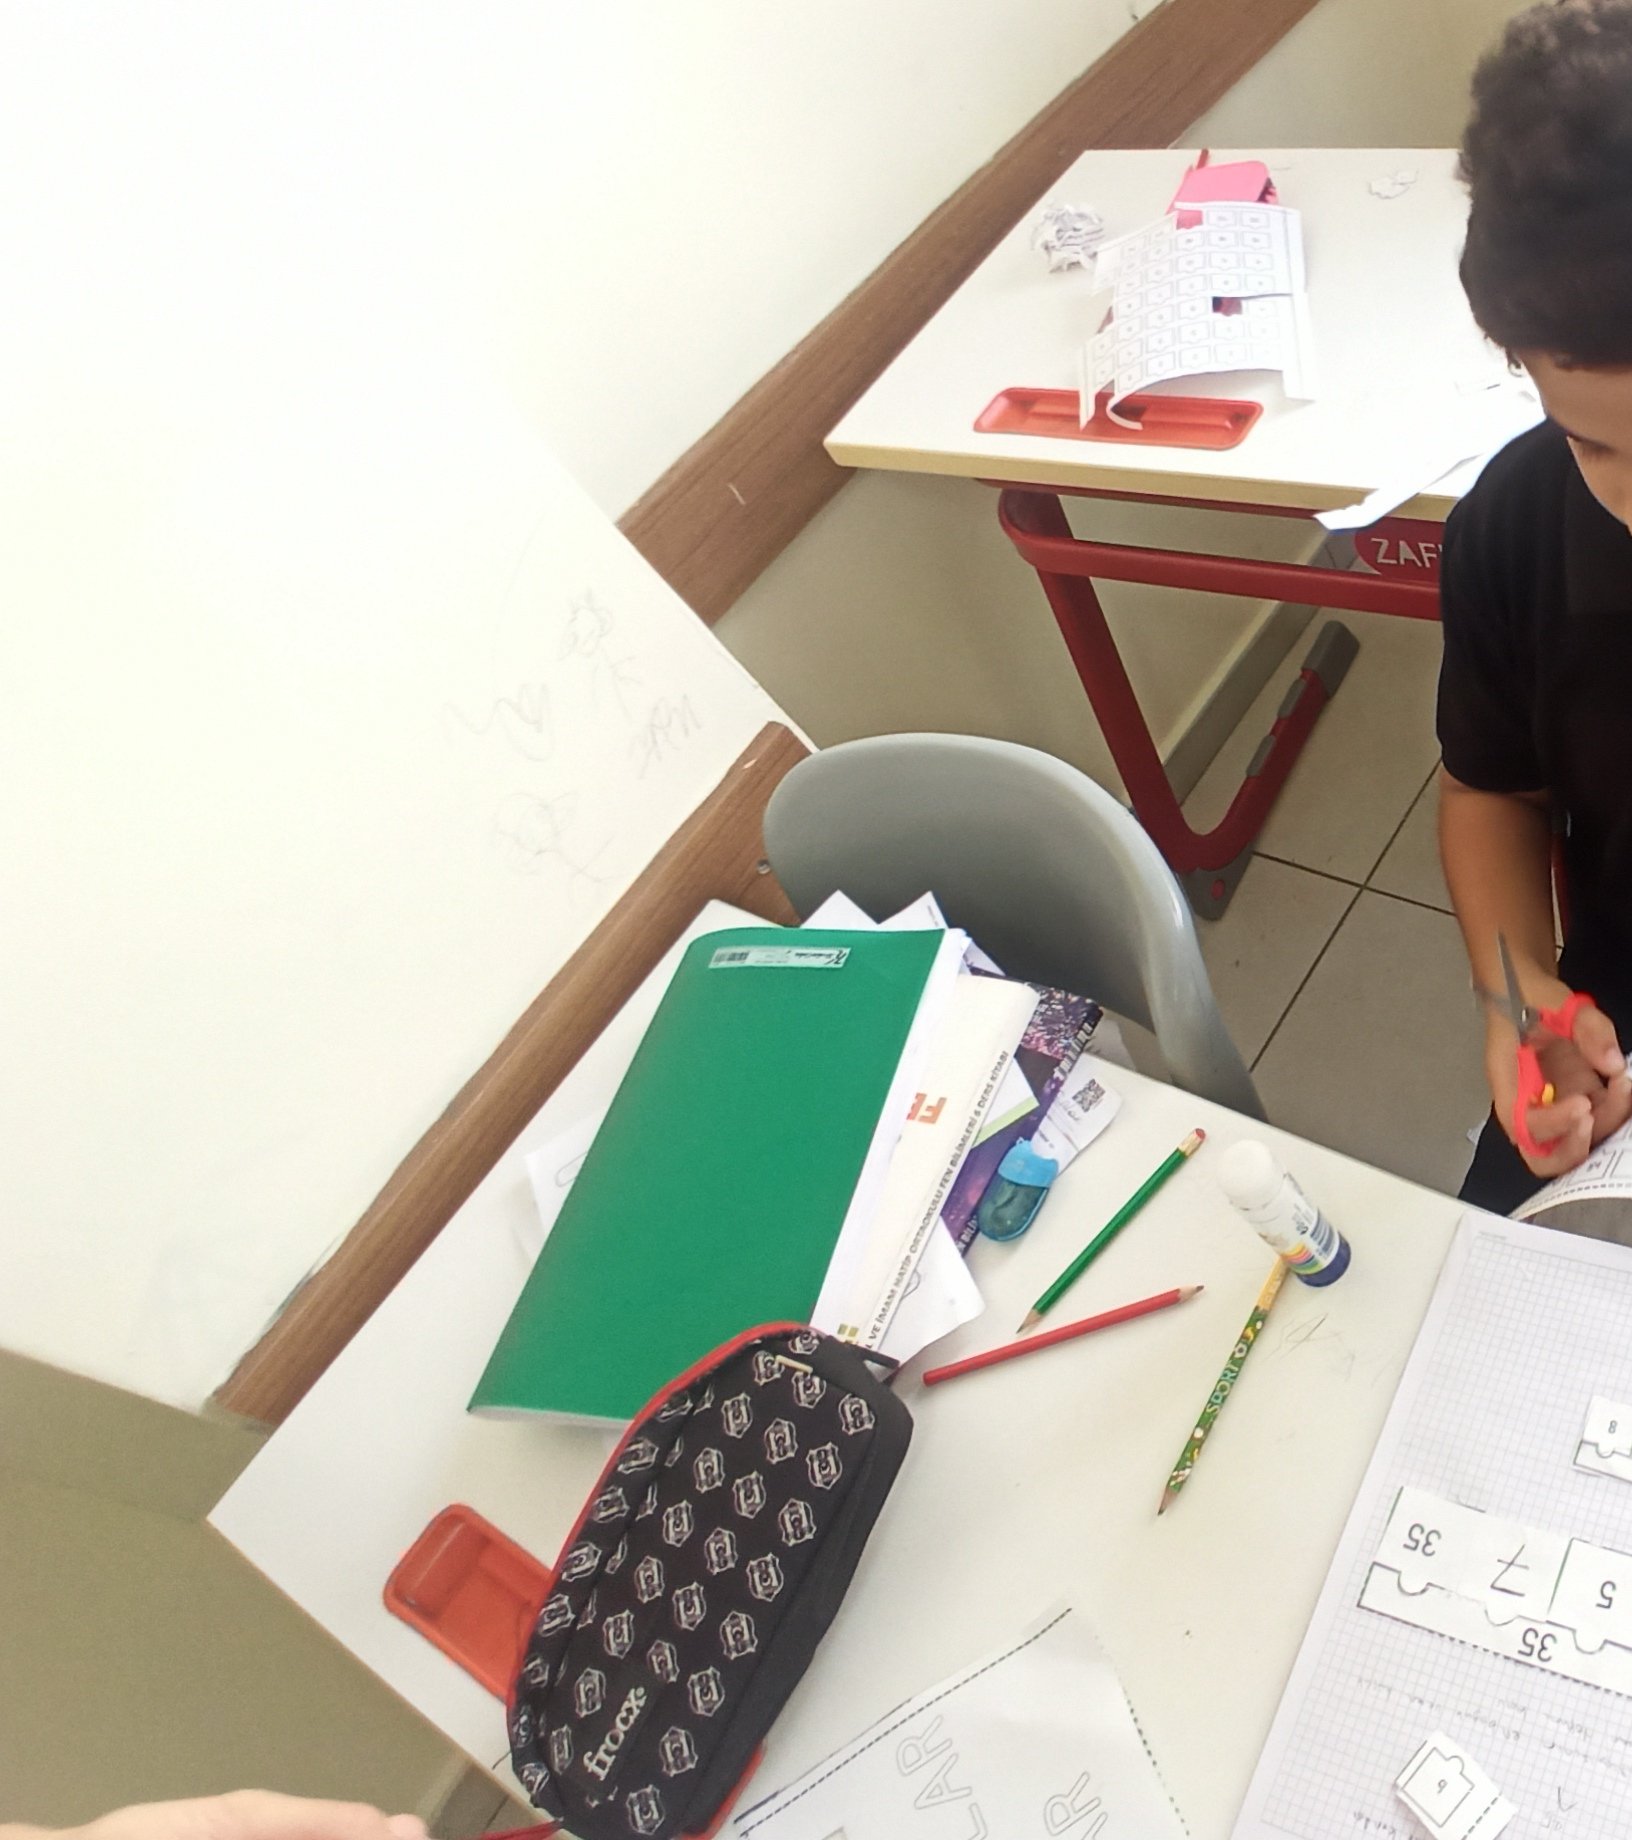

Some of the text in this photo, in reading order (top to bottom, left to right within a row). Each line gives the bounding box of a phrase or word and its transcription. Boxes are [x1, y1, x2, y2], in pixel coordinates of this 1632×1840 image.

[1370, 537, 1444, 568] ZAF
[870, 1325, 881, 1340] VE
[909, 1190, 944, 1254] ORTAOKULU
[940, 1170, 954, 1189] FEN
[978, 1083, 994, 1108] DERS
[1403, 1522, 1442, 1557] 35
[1490, 1544, 1530, 1597] 7
[1596, 1580, 1618, 1609] 5
[1518, 1626, 1558, 1663] 35
[582, 1688, 648, 1781] frocx
